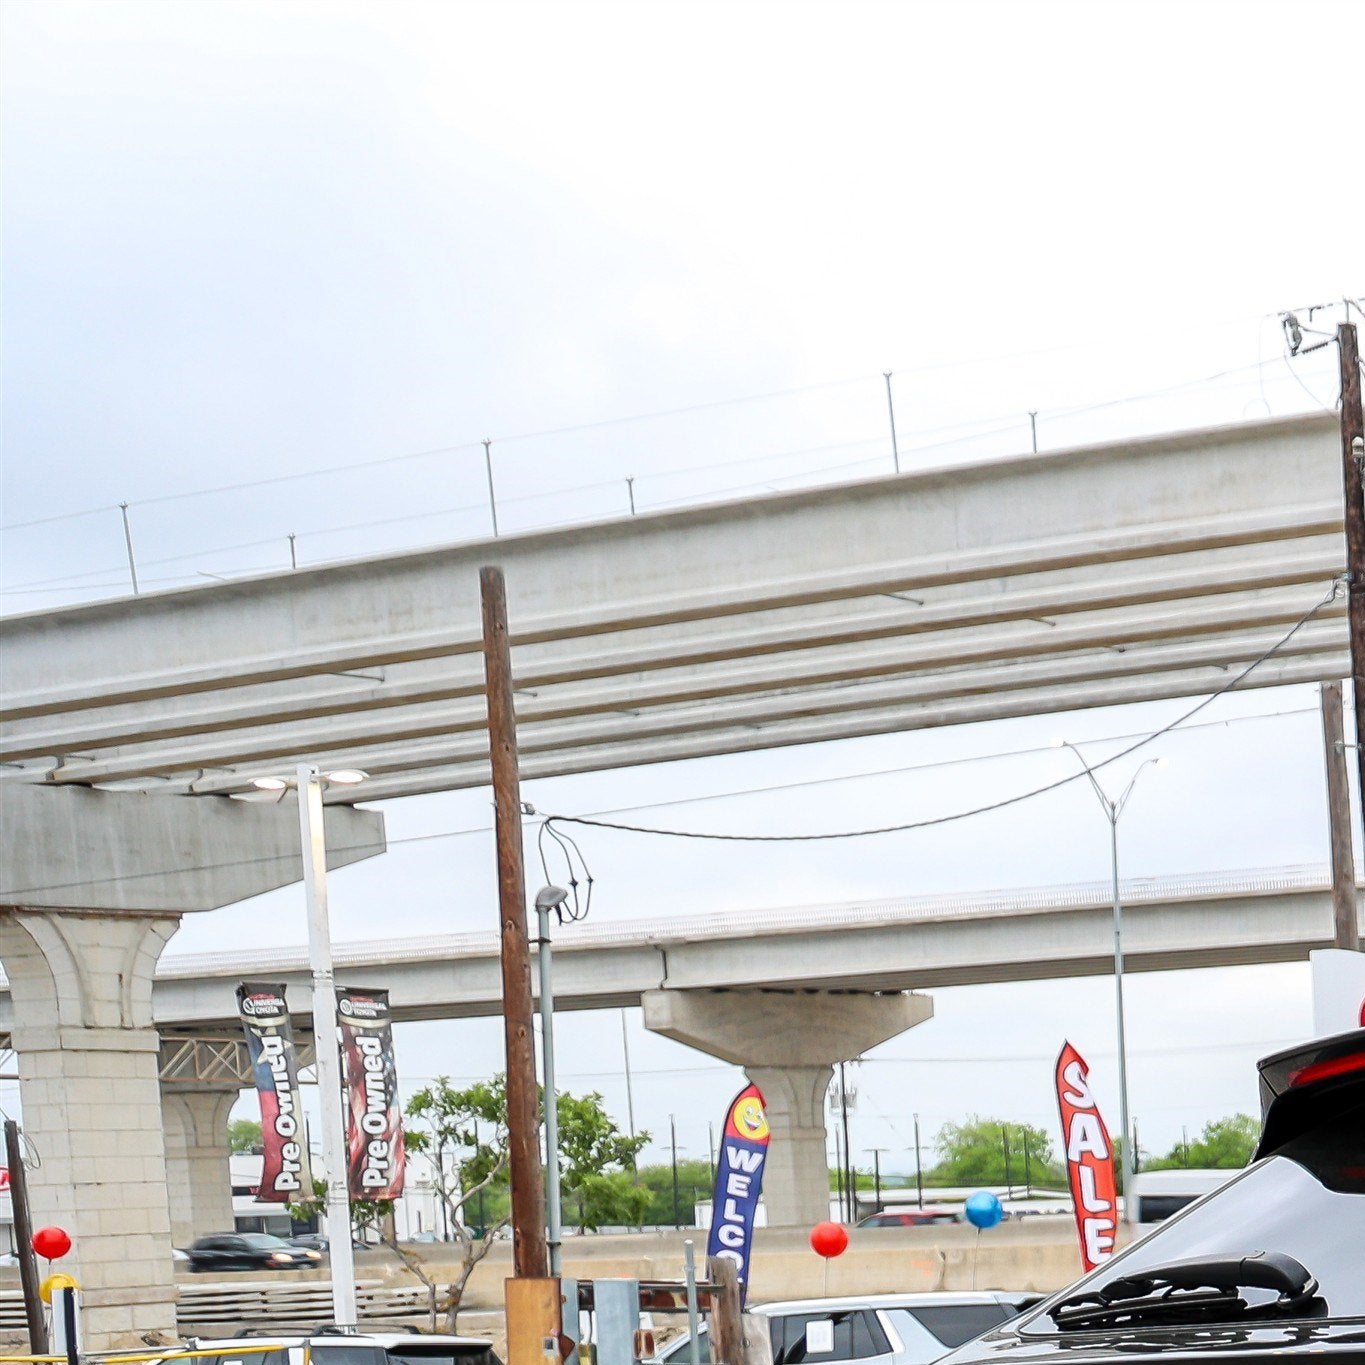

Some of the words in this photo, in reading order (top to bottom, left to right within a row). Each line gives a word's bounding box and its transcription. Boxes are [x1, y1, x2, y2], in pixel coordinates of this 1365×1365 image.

[356, 1037, 388, 1134] Owned
[716, 1146, 763, 1282] WELCO
[1063, 1060, 1115, 1264] SALE
